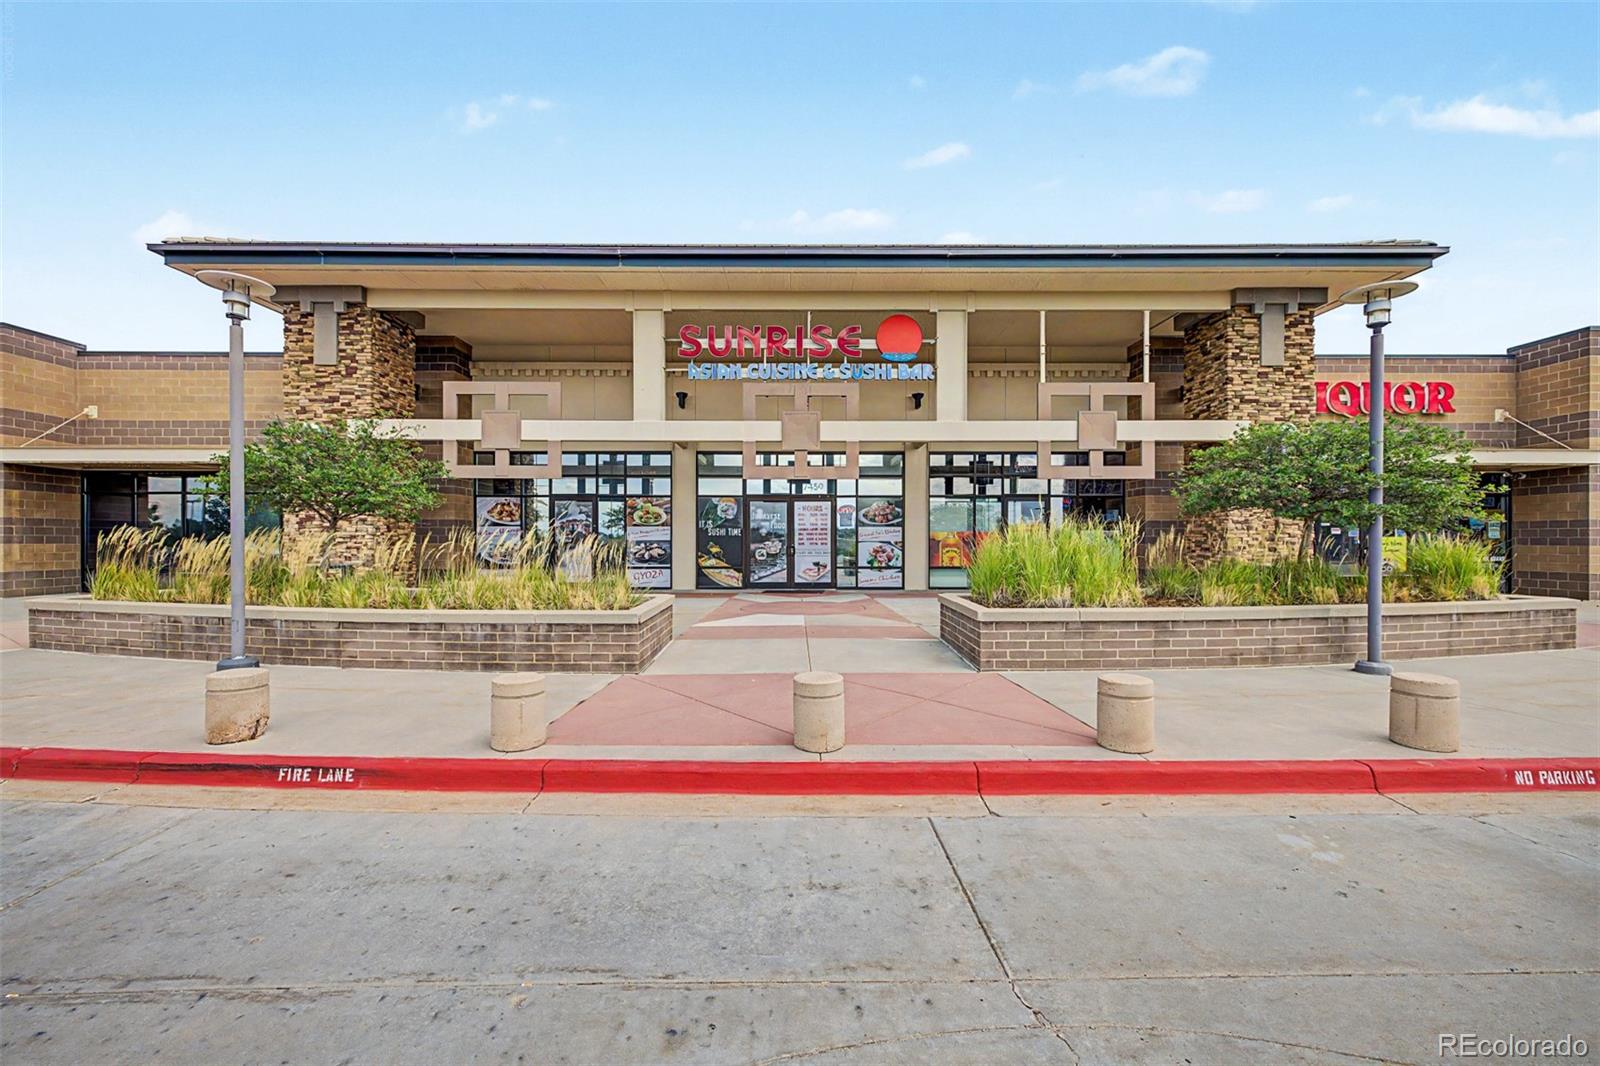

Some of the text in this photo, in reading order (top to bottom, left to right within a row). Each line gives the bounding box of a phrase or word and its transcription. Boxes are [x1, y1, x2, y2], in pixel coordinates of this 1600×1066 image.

[677, 324, 862, 358] SUNRISE
[688, 363, 936, 380] ASIAN CUISINE & SUSHI BAR
[1314, 381, 1456, 418] IQUOR
[708, 528, 742, 536] SUSHI TIME
[633, 569, 664, 583] GYOZA
[278, 767, 355, 782] FIRE LANE
[1514, 769, 1596, 785] NO PARKING
